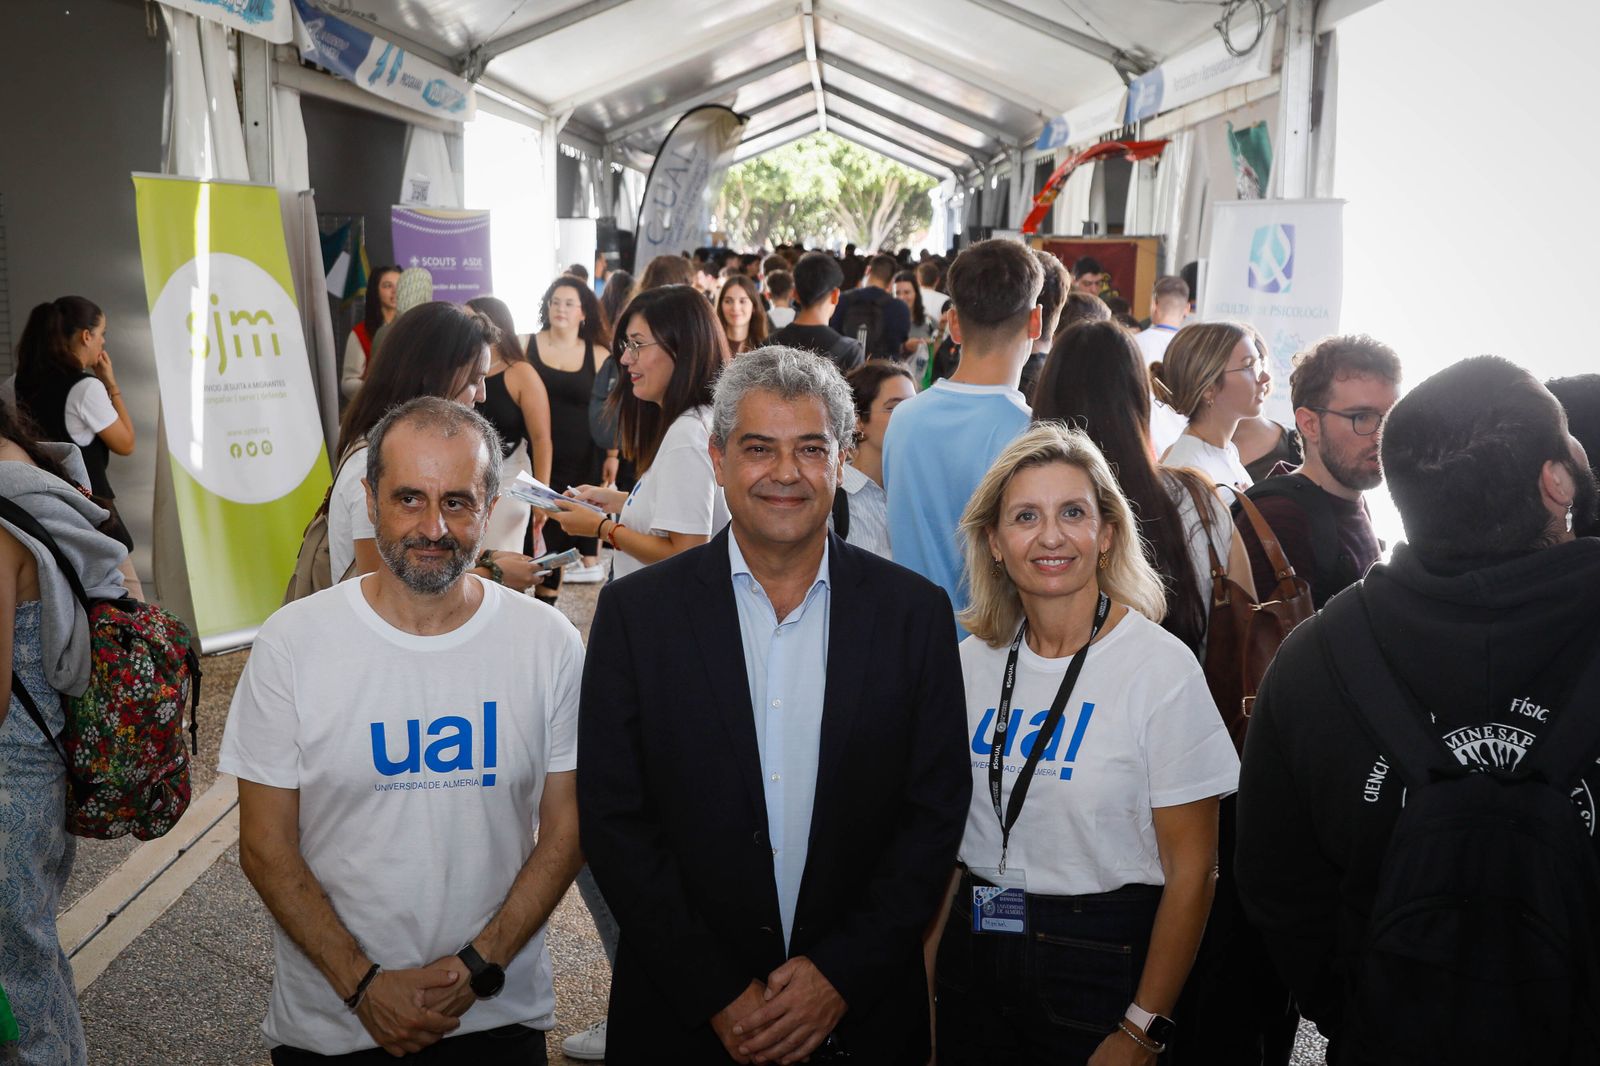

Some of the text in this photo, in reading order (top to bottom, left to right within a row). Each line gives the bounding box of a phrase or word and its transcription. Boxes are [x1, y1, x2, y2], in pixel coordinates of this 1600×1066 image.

[421, 256, 482, 267] SCOUTS ASDE
[185, 293, 281, 376] sjm
[223, 382, 246, 392] JESUITA
[253, 379, 286, 389] MIGRANTES
[1510, 697, 1549, 723] FÍSIC
[370, 701, 497, 787] ua!
[971, 701, 1095, 781] ua!
[1445, 726, 1534, 751] MINE SAP
[374, 781, 428, 792] UNIVERSIDAD
[428, 780, 441, 790] DE
[1363, 755, 1391, 802] CIENCI
